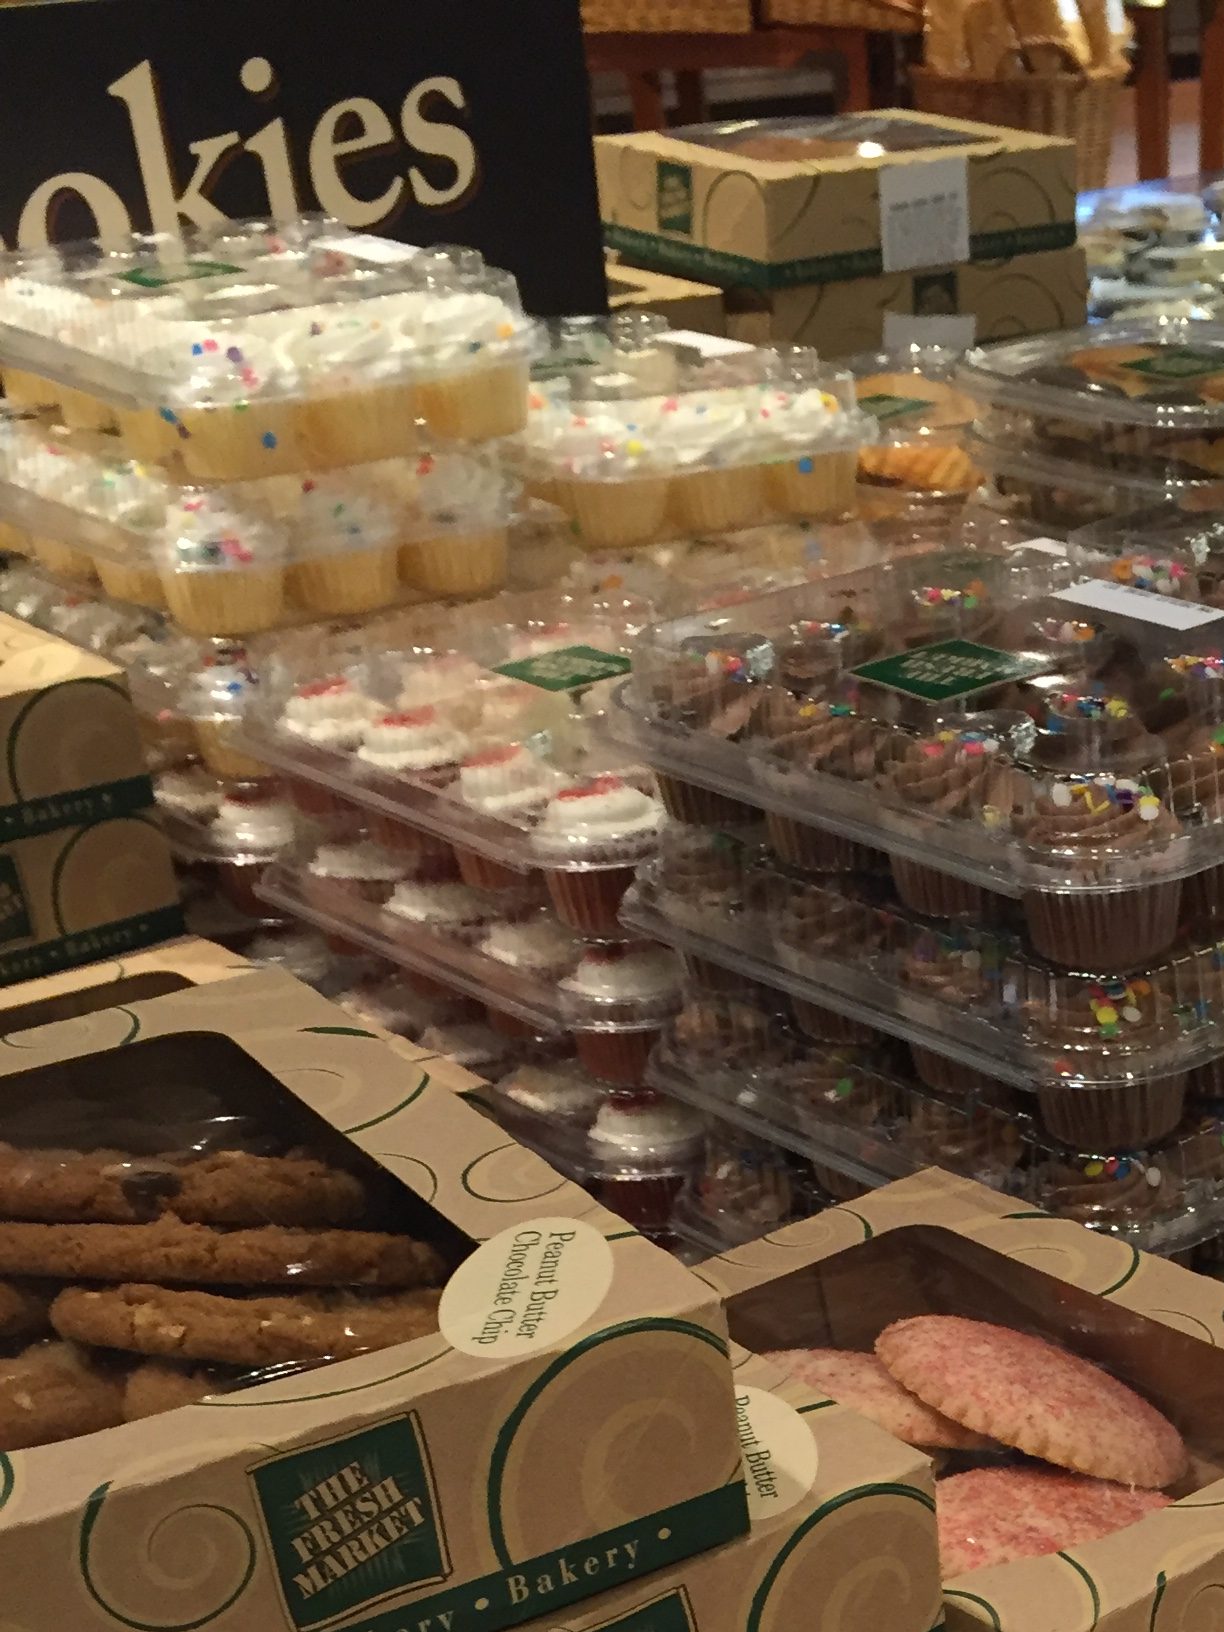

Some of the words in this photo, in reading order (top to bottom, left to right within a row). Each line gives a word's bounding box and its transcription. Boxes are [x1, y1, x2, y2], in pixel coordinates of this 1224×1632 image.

[0, 57, 477, 250] okies
[494, 1230, 542, 1305] Chocolate
[539, 1230, 576, 1288] Peanut
[472, 1301, 513, 1345] Chip
[516, 1287, 559, 1340] Butter
[294, 1460, 370, 1522] THE
[745, 1449, 778, 1499] Butter
[290, 1475, 406, 1564] FRESH
[292, 1497, 426, 1599] MARKET
[507, 1538, 641, 1605] Bakery
